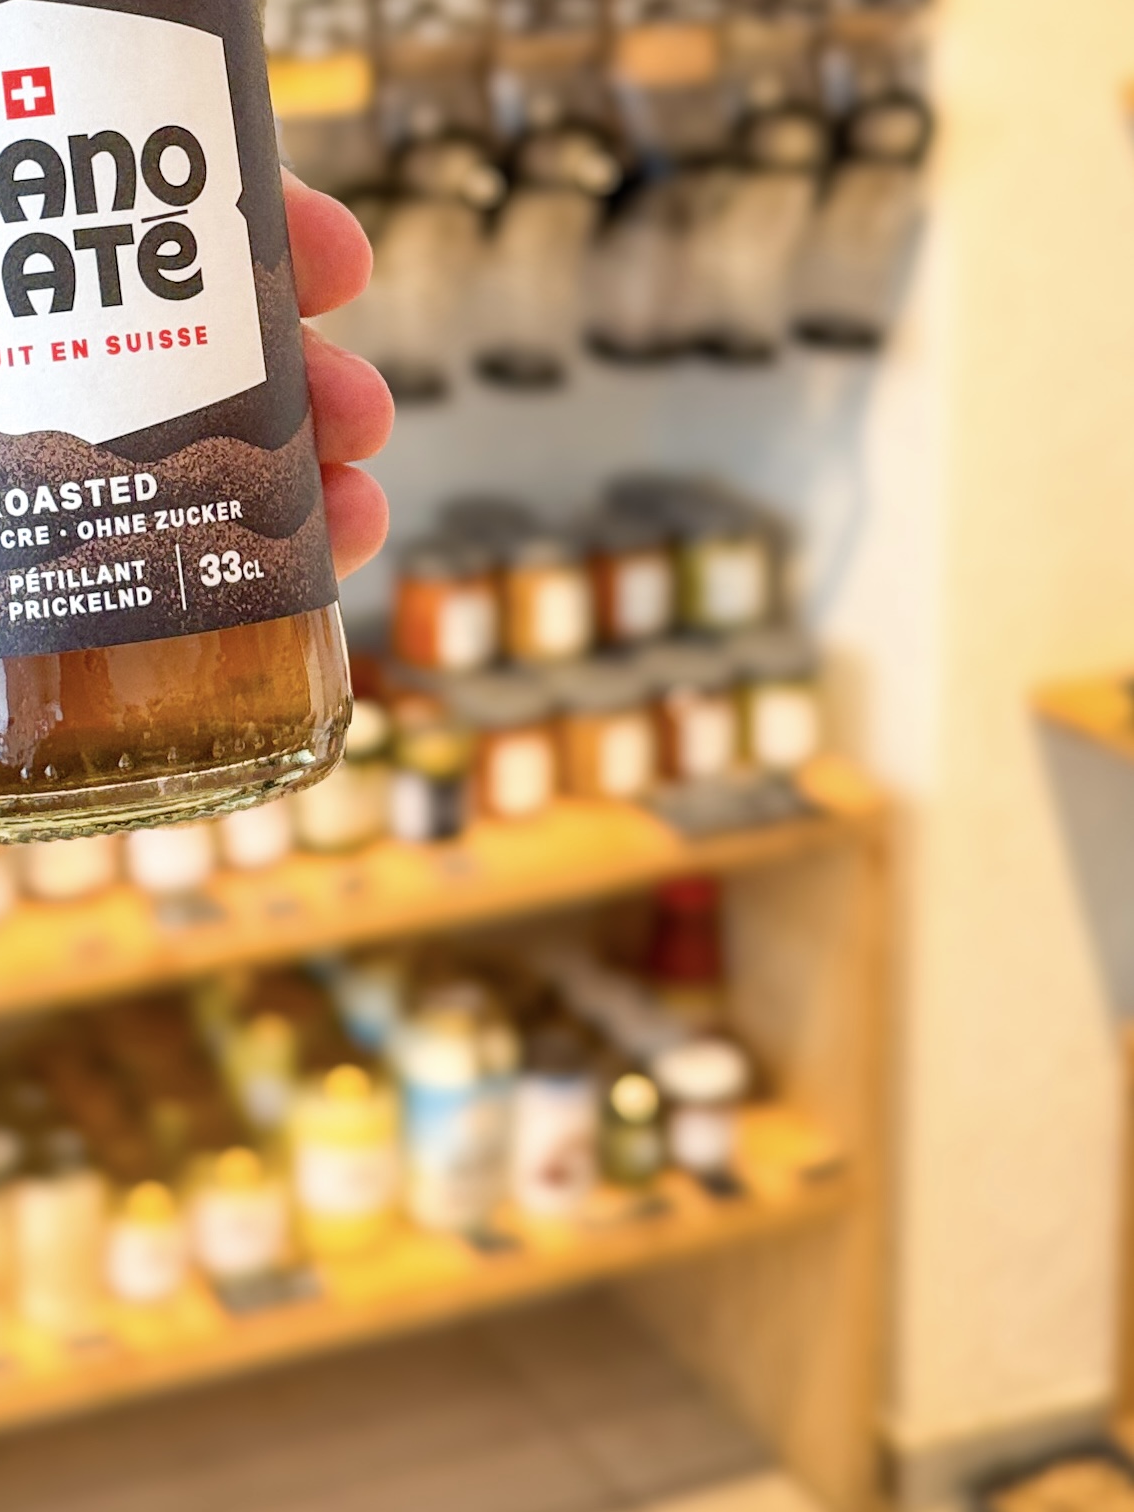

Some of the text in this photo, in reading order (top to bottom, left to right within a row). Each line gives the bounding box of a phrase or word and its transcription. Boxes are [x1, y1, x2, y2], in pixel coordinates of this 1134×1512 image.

[51, 339, 89, 361] EN
[106, 325, 209, 355] SUISSE
[77, 513, 146, 540] OHNE
[154, 499, 244, 530] ZUCKER
[8, 559, 146, 595] PÉTILLANT
[8, 586, 153, 621] PRICKELND
